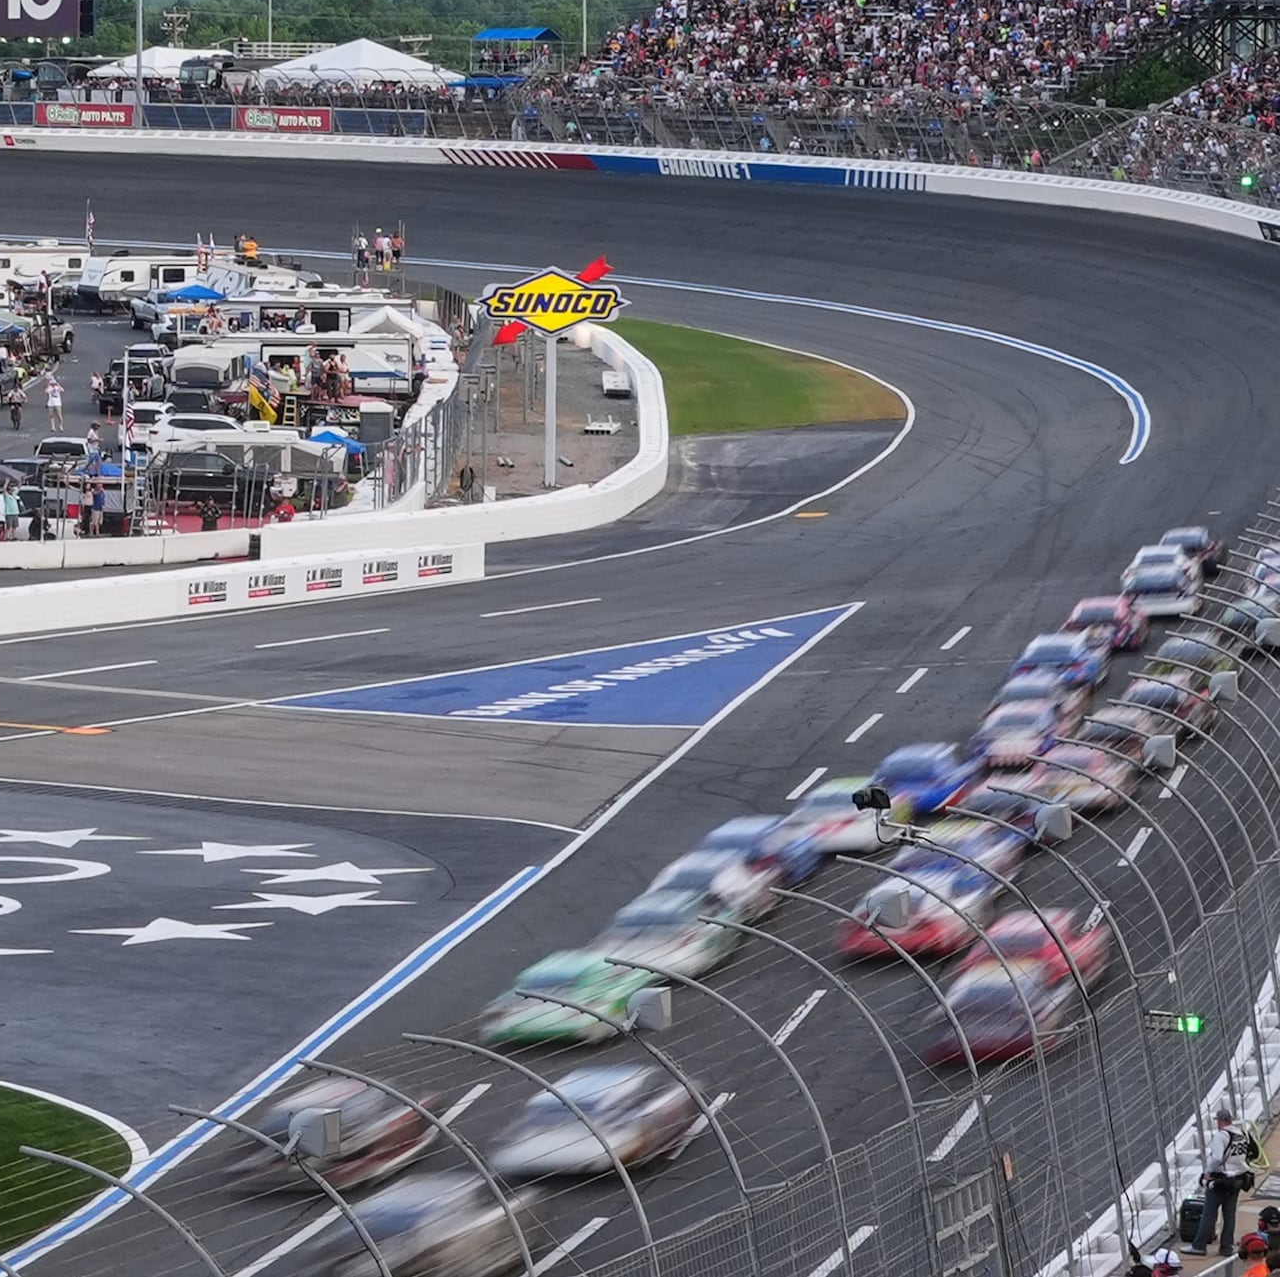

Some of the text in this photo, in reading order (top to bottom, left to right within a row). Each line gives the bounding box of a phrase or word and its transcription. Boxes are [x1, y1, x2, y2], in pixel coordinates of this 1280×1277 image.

[81, 111, 100, 121] AUTO
[657, 157, 752, 180] CHARLOTTE 1
[493, 291, 612, 314] SUNOCO
